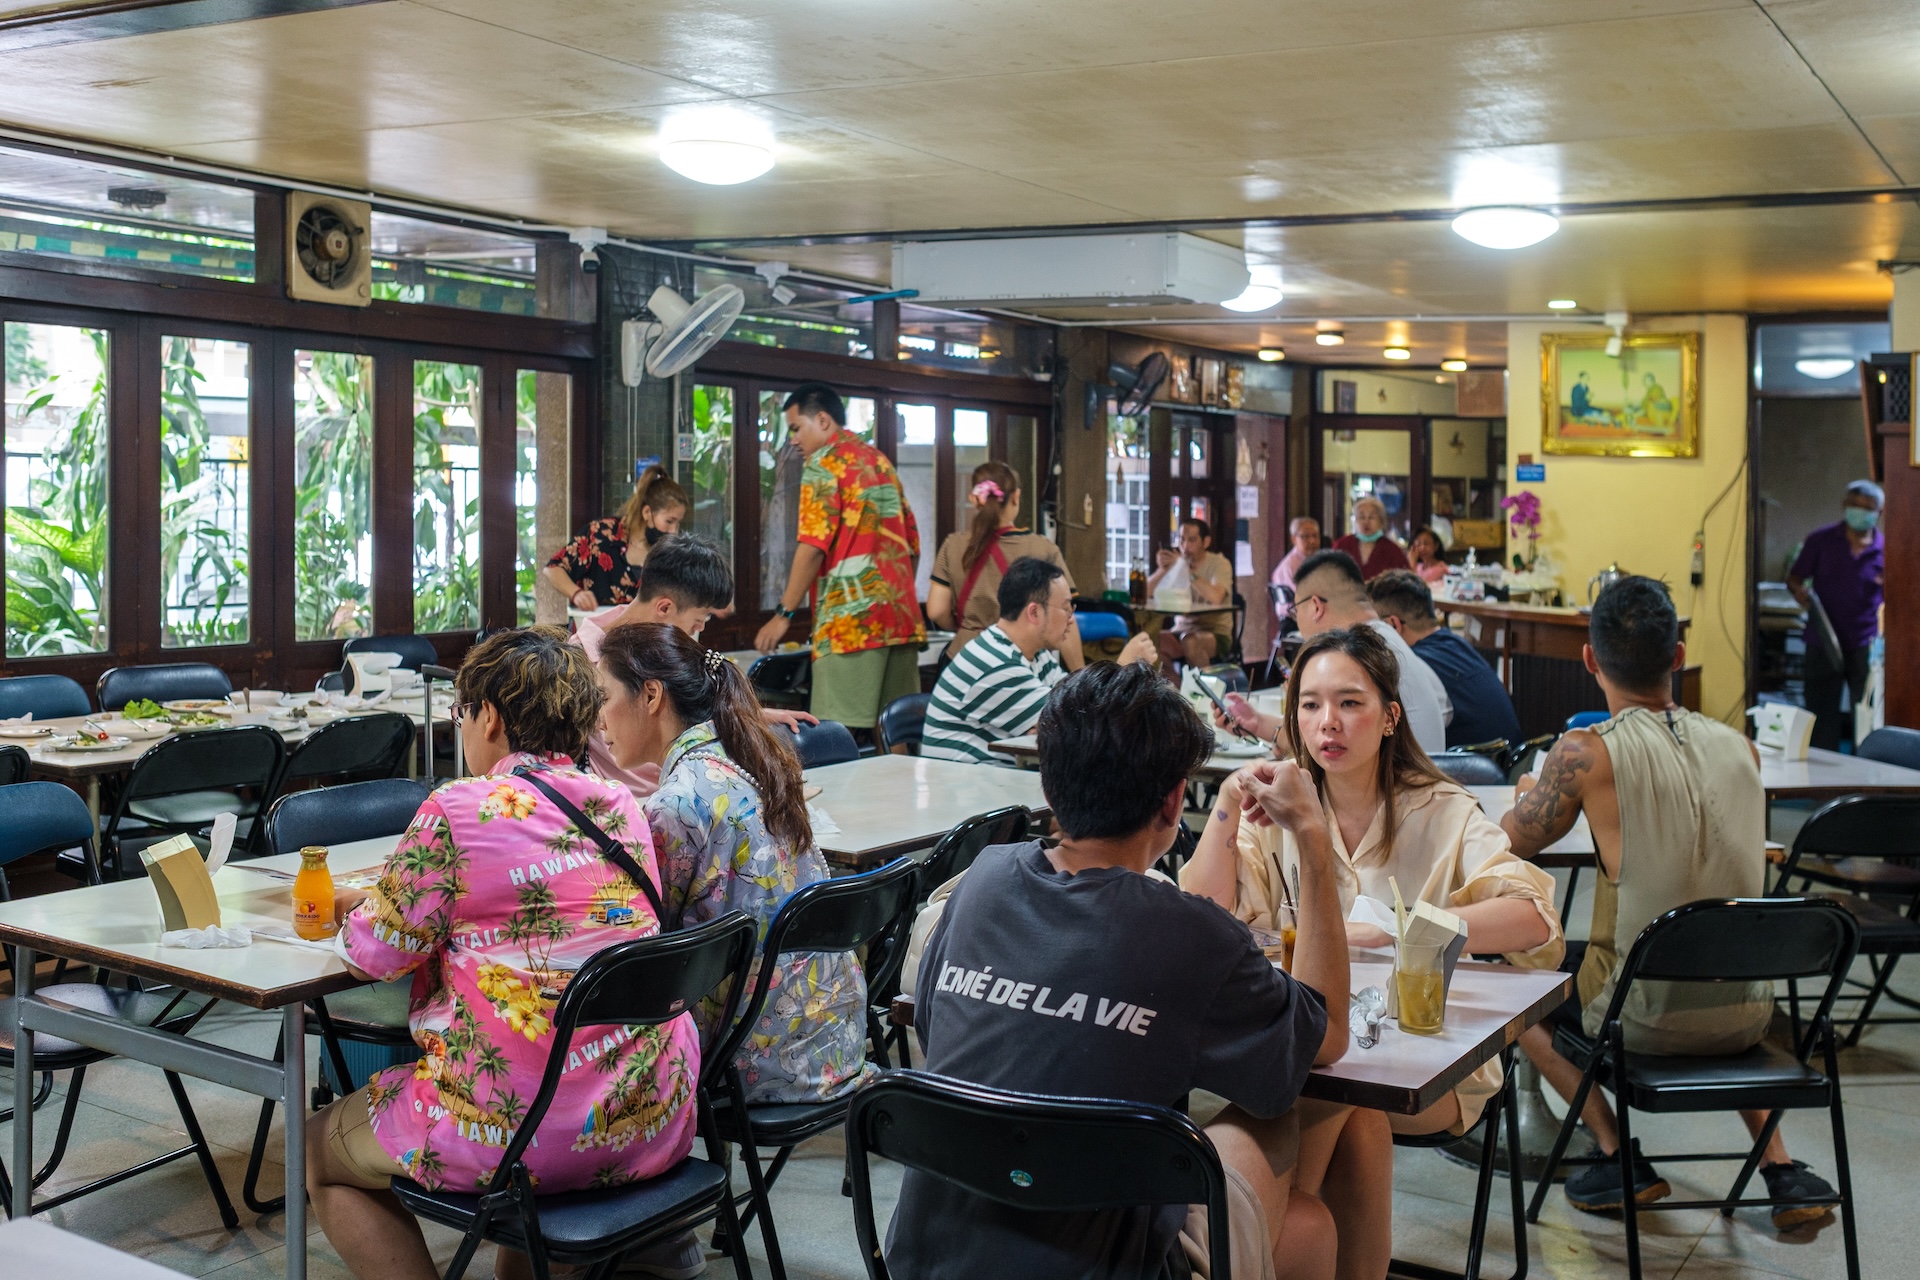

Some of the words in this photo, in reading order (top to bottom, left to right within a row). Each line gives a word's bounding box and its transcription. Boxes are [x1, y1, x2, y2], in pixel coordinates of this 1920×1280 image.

[508, 848, 594, 887] HAWAII
[986, 977, 1037, 1010] DE
[1031, 986, 1089, 1022] LA
[1094, 997, 1158, 1037] VIE
